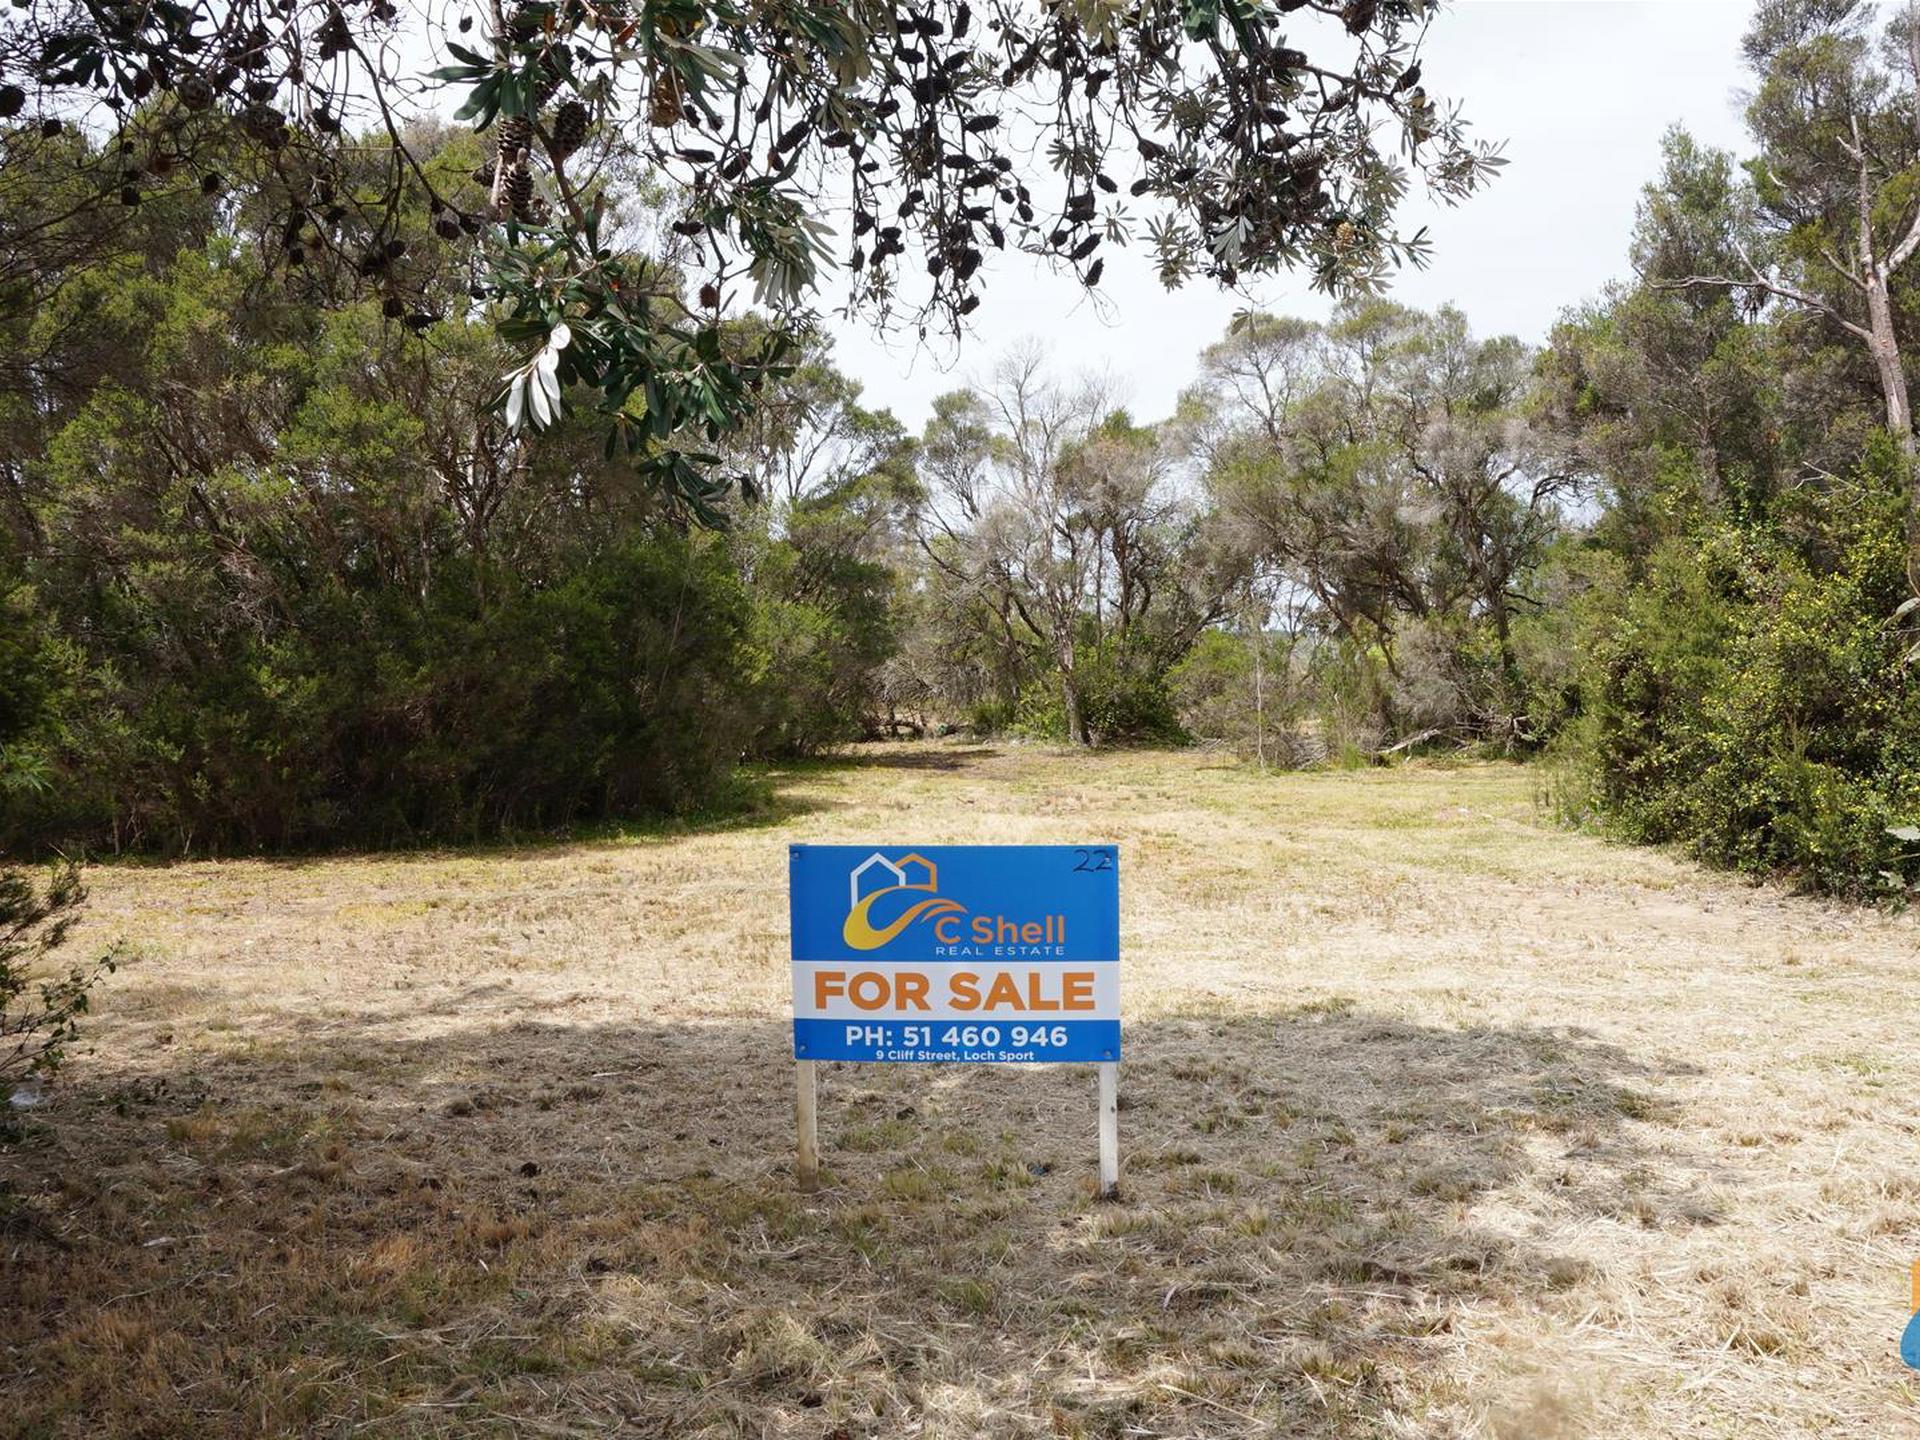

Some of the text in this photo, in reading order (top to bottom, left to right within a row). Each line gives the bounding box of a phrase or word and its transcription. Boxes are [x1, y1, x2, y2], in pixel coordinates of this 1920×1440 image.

[1072, 849, 1113, 873] 22
[934, 914, 1065, 944] C Shell
[936, 946, 1065, 956] REAL ESTATE
[814, 971, 1096, 1011] FOR SALE
[846, 1025, 1068, 1047] PH: 51 460 946
[876, 1049, 1035, 1062] 9 Cliff Street, Loch Sport
